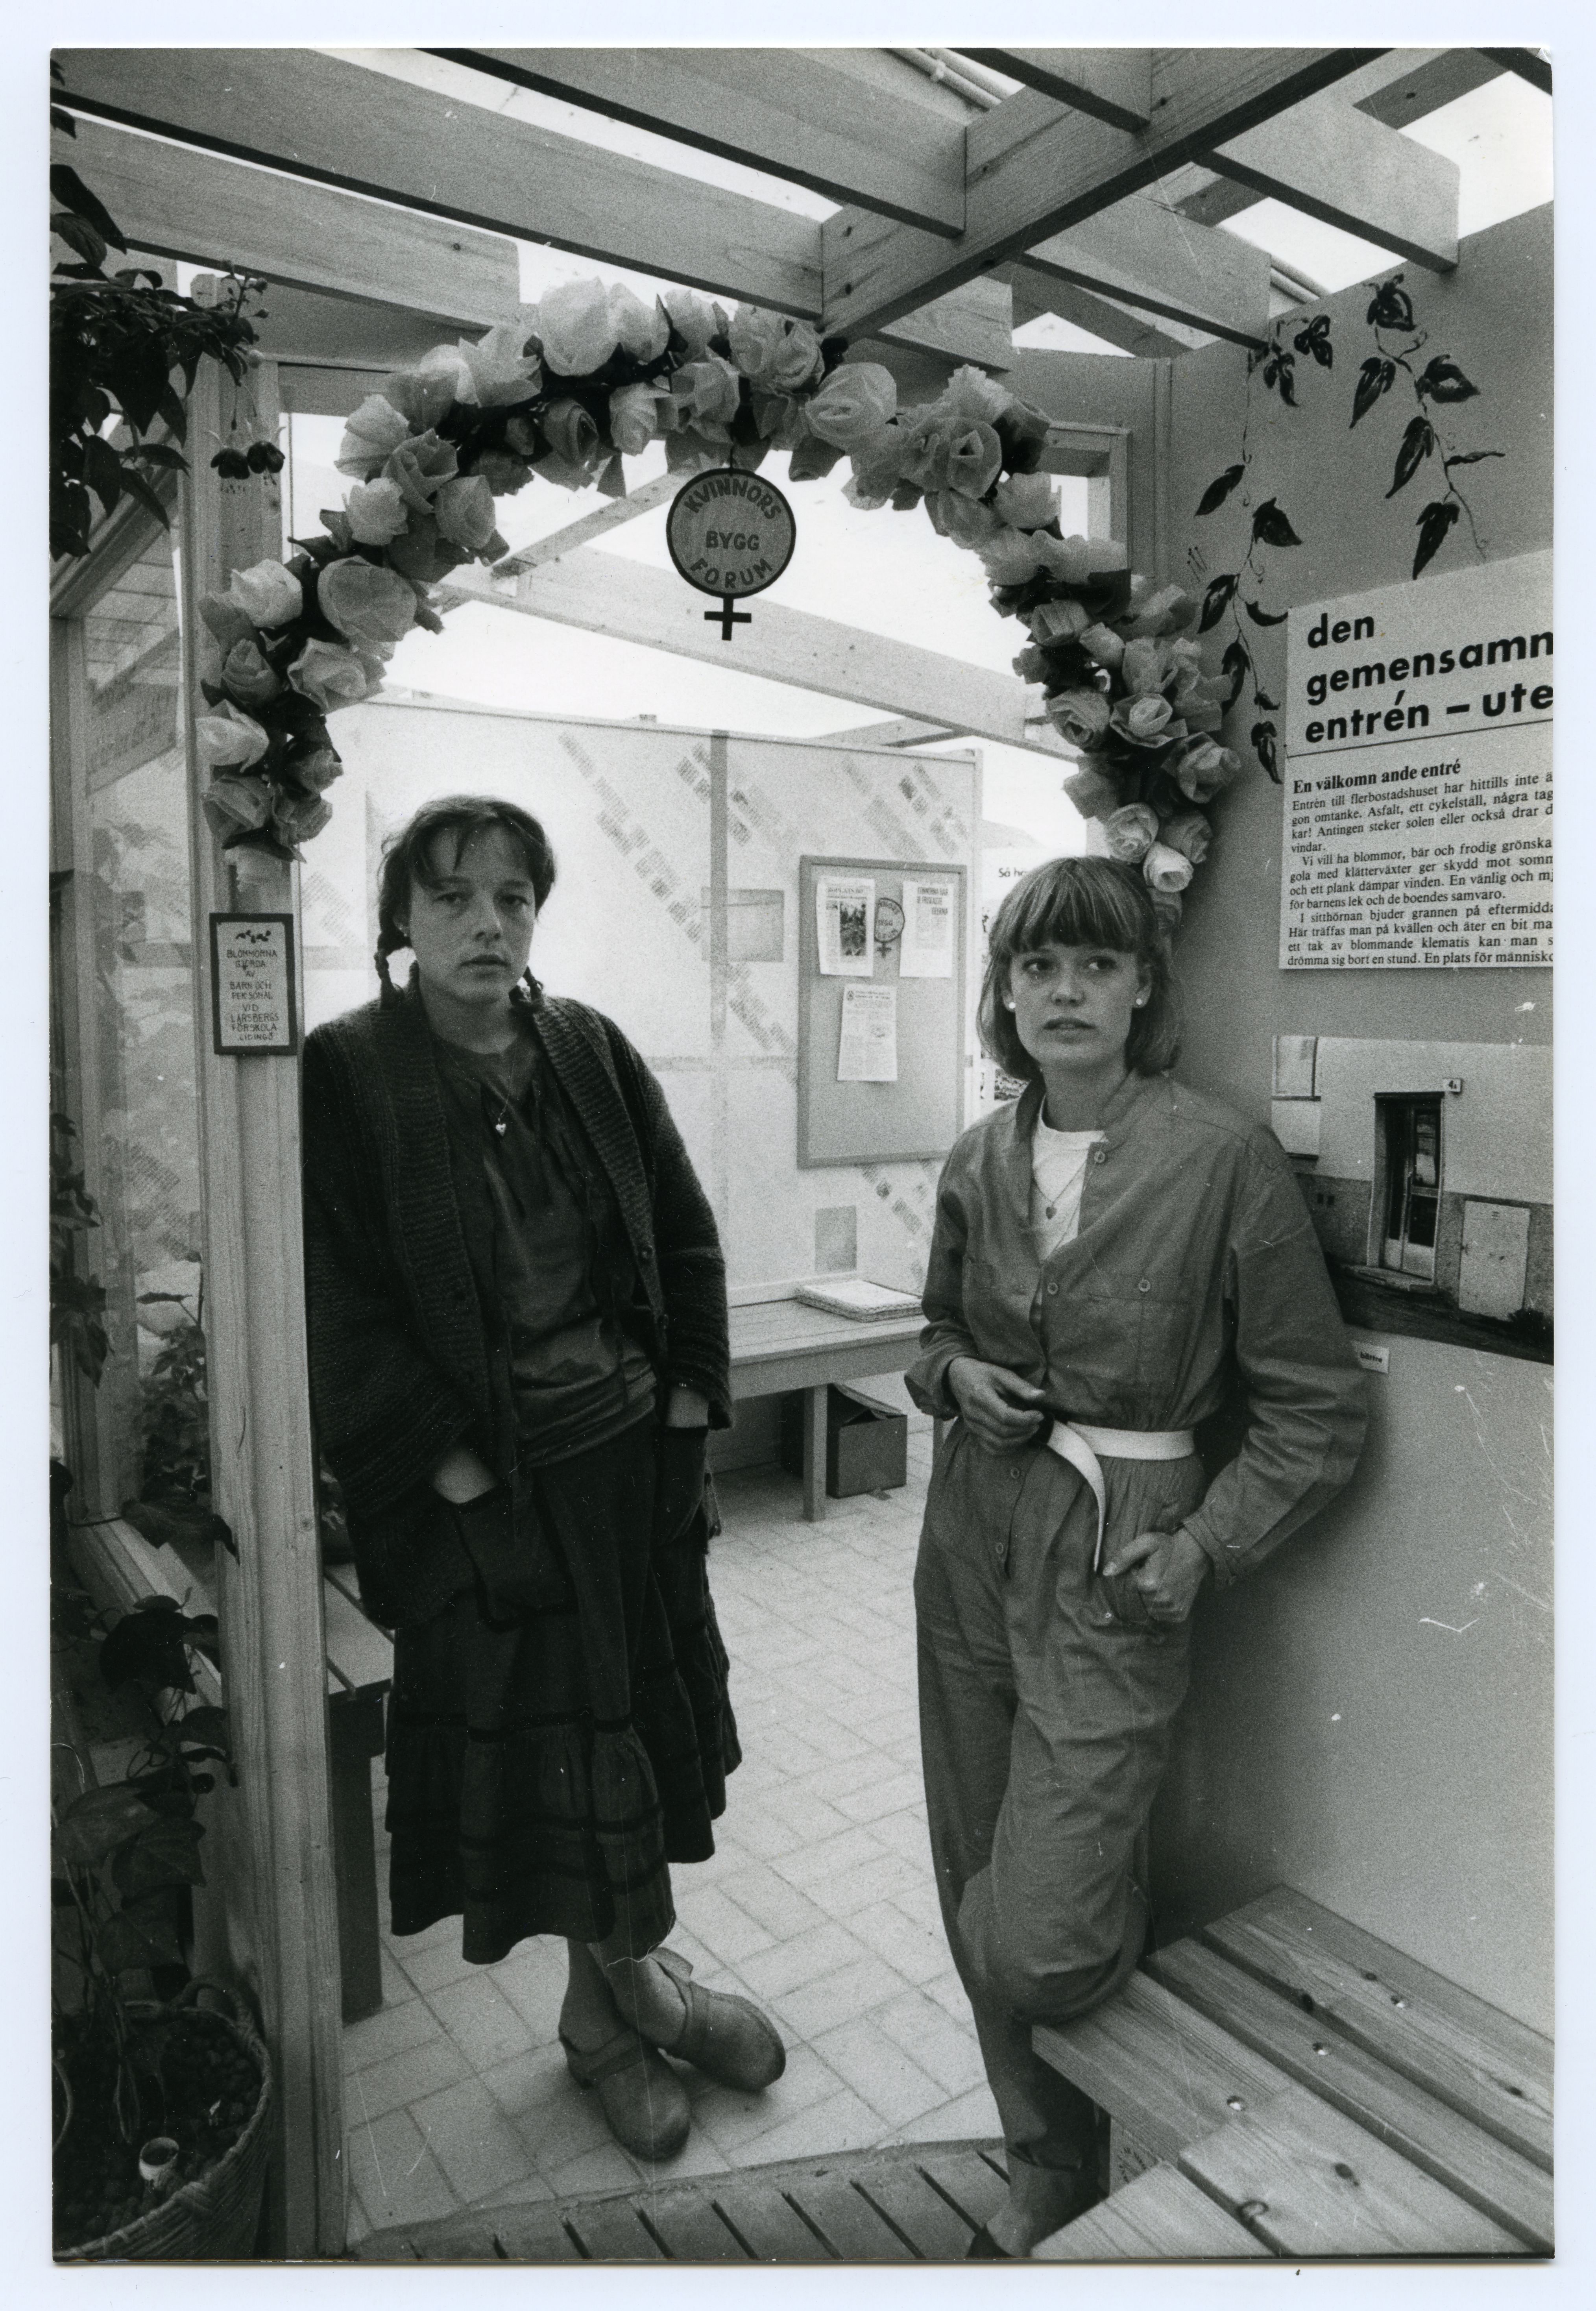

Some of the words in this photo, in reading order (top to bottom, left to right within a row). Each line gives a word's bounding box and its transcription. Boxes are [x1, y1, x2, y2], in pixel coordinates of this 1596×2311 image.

[684, 478, 781, 519] KVINNORS
[706, 531, 759, 551] BYGG
[690, 558, 772, 589] FORUM
[1308, 612, 1374, 648] den
[1306, 690, 1429, 743] entrén
[1483, 683, 1553, 717] ute
[1293, 780, 1312, 794] En
[1421, 759, 1461, 778] entré
[1293, 798, 1326, 811] Entrén
[1332, 795, 1345, 806] till
[1351, 786, 1438, 804] flerbostadshuset
[1444, 782, 1464, 793] har
[1470, 776, 1508, 790] hittills
[1515, 775, 1539, 786] inte
[1292, 815, 1310, 826] gon
[1315, 809, 1362, 823] omtanke.
[1368, 804, 1404, 817] Asfalt,
[1409, 802, 1423, 812] ett
[1429, 795, 1487, 812] cykelställ,
[1493, 792, 1528, 804] några
[1292, 827, 1312, 839] kar!
[1317, 825, 1364, 837] Antingen
[1369, 819, 1401, 832] steker
[1406, 816, 1434, 828] solen
[1441, 813, 1465, 825] eller
[1472, 808, 1505, 822] också
[1512, 806, 1539, 818] drar
[1291, 842, 1326, 853] vindar.
[1302, 856, 1313, 866] Vi
[1318, 854, 1332, 865] vill
[1337, 853, 1349, 864] ha
[1354, 850, 1406, 862] blommor,
[1411, 847, 1429, 858] bär
[1434, 845, 1454, 856] och
[1460, 841, 1496, 854] frodig
[1502, 837, 1552, 853] grönska
[1290, 871, 1310, 883] gola
[1317, 868, 1338, 879] med
[1345, 865, 1412, 877] klätterväxter
[1419, 863, 1436, 874] ger
[1444, 858, 1478, 871] skydd
[1487, 858, 1511, 867] mot
[1290, 885, 1307, 895] och
[1311, 884, 1323, 894] ett
[1327, 882, 1355, 895] plank
[1359, 881, 1399, 891] dämpar
[1404, 877, 1444, 888] vinden.
[1449, 874, 1465, 886] En
[1470, 872, 1506, 885] vänlig
[1511, 870, 1533, 882] och
[1290, 899, 1304, 910] för
[1307, 898, 1346, 908] barnens
[1348, 896, 1363, 906] lek
[1366, 894, 1385, 905] och
[1387, 894, 1400, 904] de
[1403, 891, 1448, 903] boendes
[1452, 890, 1505, 901] samvaro.
[1300, 913, 1304, 923] I
[1311, 912, 1363, 923] sitthörnan
[1370, 909, 1404, 921] bjuder
[1412, 908, 1457, 920] grannen
[1466, 905, 1480, 918] på
[1289, 927, 1308, 937] Här
[1312, 926, 1345, 936] träffas
[1349, 926, 1372, 935] man
[1376, 923, 1389, 936] på
[1394, 922, 1433, 934] kvällen
[1438, 921, 1458, 932] och
[1491, 922, 1505, 930] en
[1511, 919, 1528, 930] bit
[227, 949, 277, 958] BLOMMORNA
[1288, 942, 1300, 951] ett
[1308, 941, 1323, 951] tak
[1350, 938, 1413, 950] blommande
[1422, 936, 1469, 948] klematis
[1479, 935, 1501, 947] kan
[1510, 937, 1538, 946] man
[1288, 956, 1329, 965] drömma
[1332, 955, 1345, 966] sig
[1348, 954, 1370, 964] bort
[1372, 956, 1384, 964] en
[1387, 953, 1421, 964] stund.
[1424, 953, 1440, 963] En
[1443, 952, 1471, 964] plats
[1474, 951, 1493, 963] för
[230, 982, 252, 990] BARN
[242, 1004, 259, 1012] VID
